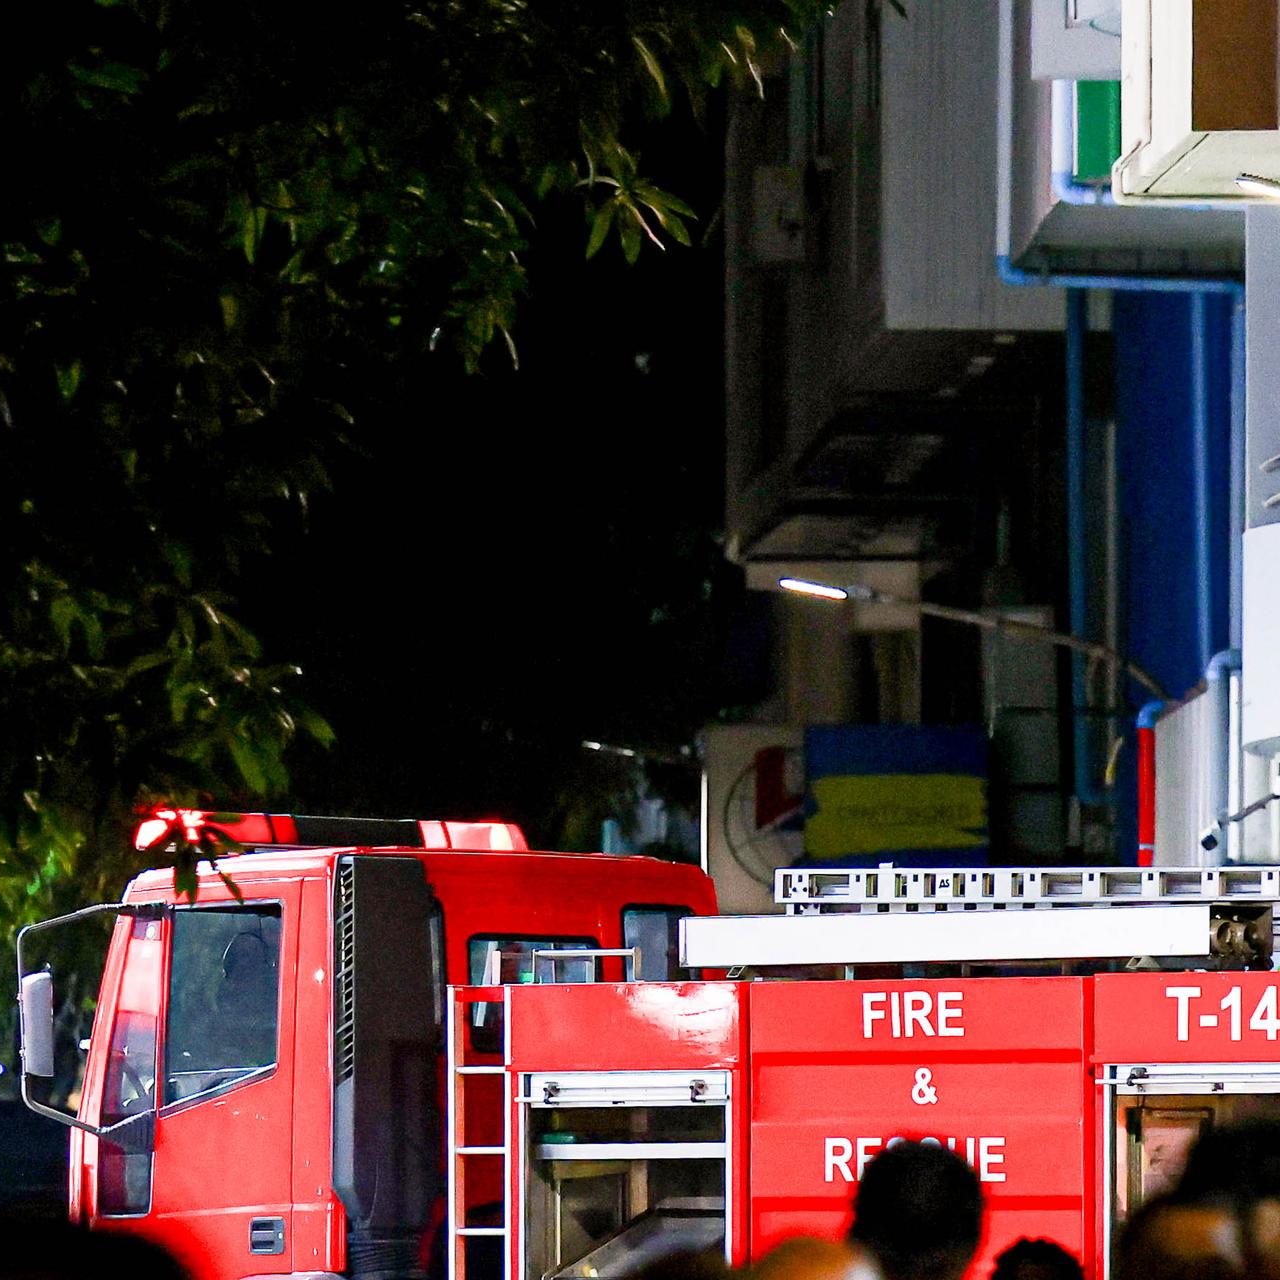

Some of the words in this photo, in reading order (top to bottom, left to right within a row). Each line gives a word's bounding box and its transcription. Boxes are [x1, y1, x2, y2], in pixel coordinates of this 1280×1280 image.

[862, 991, 965, 1038] FIRE
[911, 1067, 938, 1105] &
[824, 1137, 1006, 1182] REE
